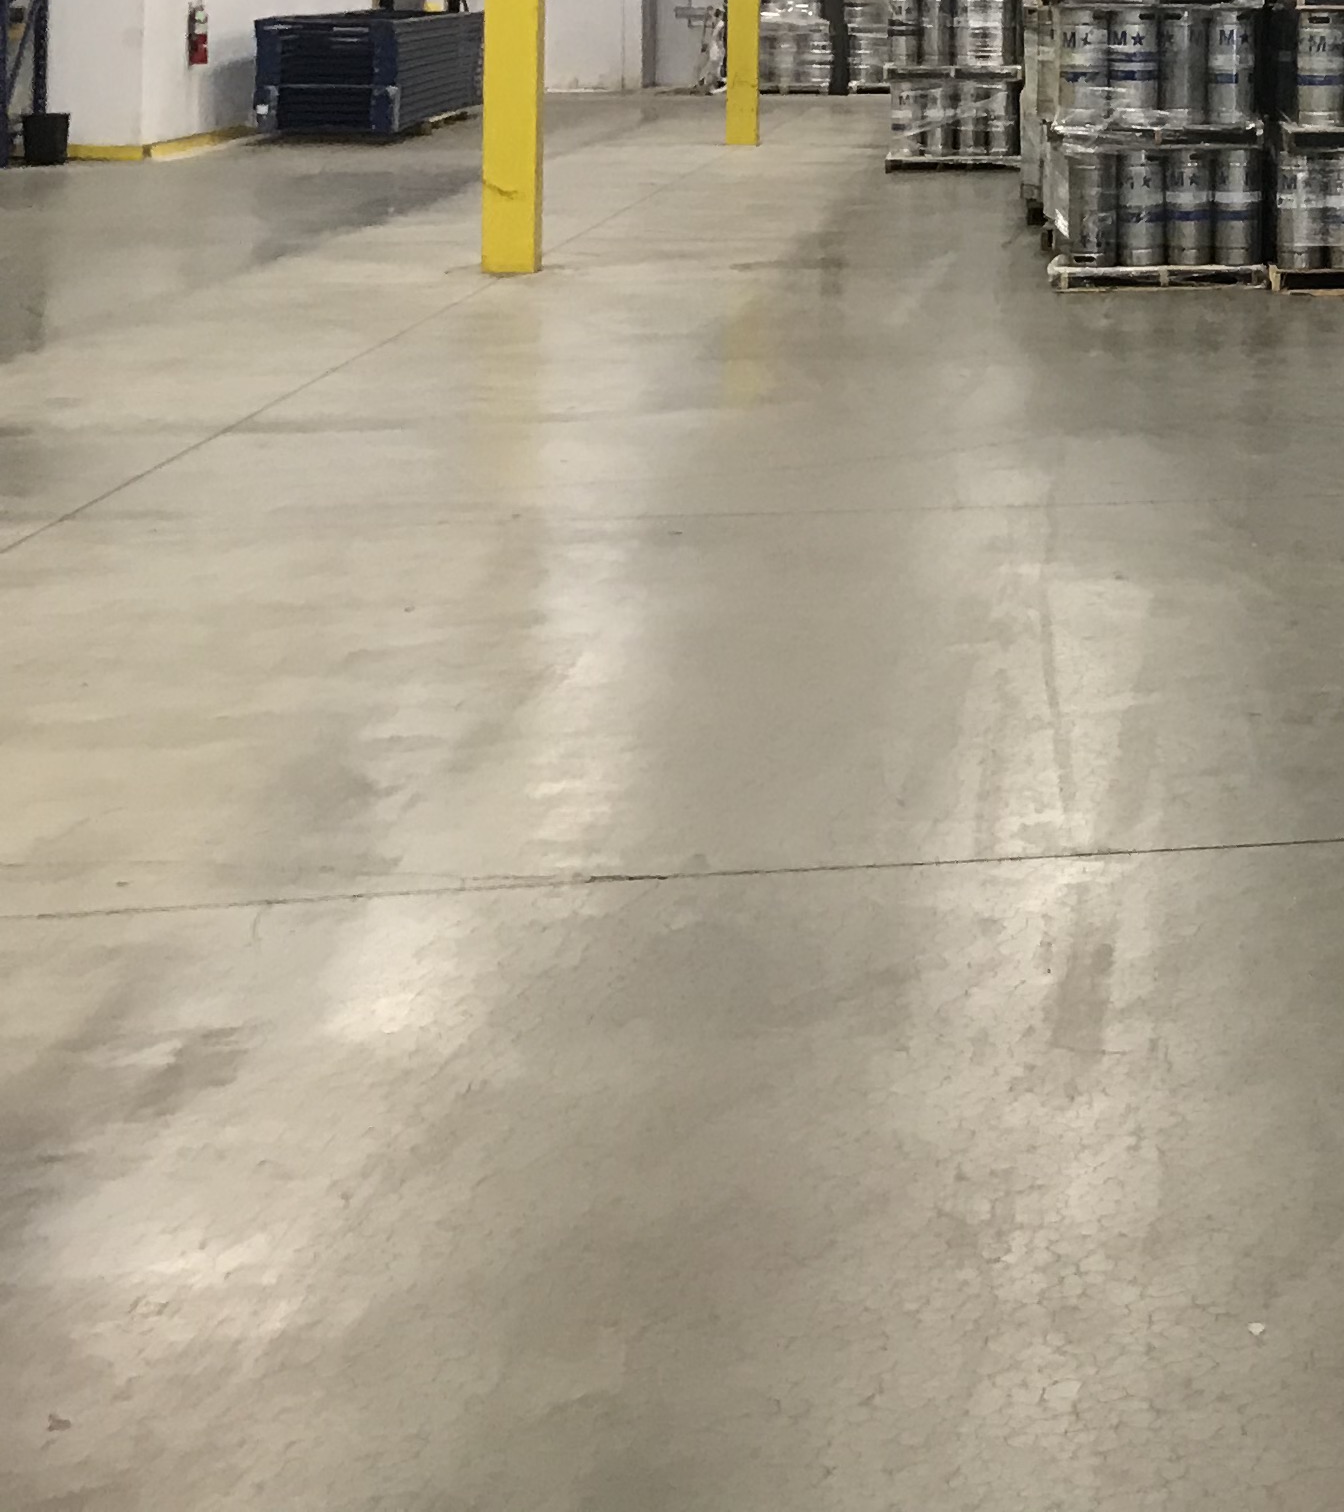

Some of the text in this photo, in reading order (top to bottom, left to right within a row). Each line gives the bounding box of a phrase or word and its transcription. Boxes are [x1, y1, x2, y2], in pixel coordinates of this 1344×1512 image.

[1063, 32, 1076, 48] M
[1113, 30, 1127, 46] M
[1220, 29, 1235, 46] M
